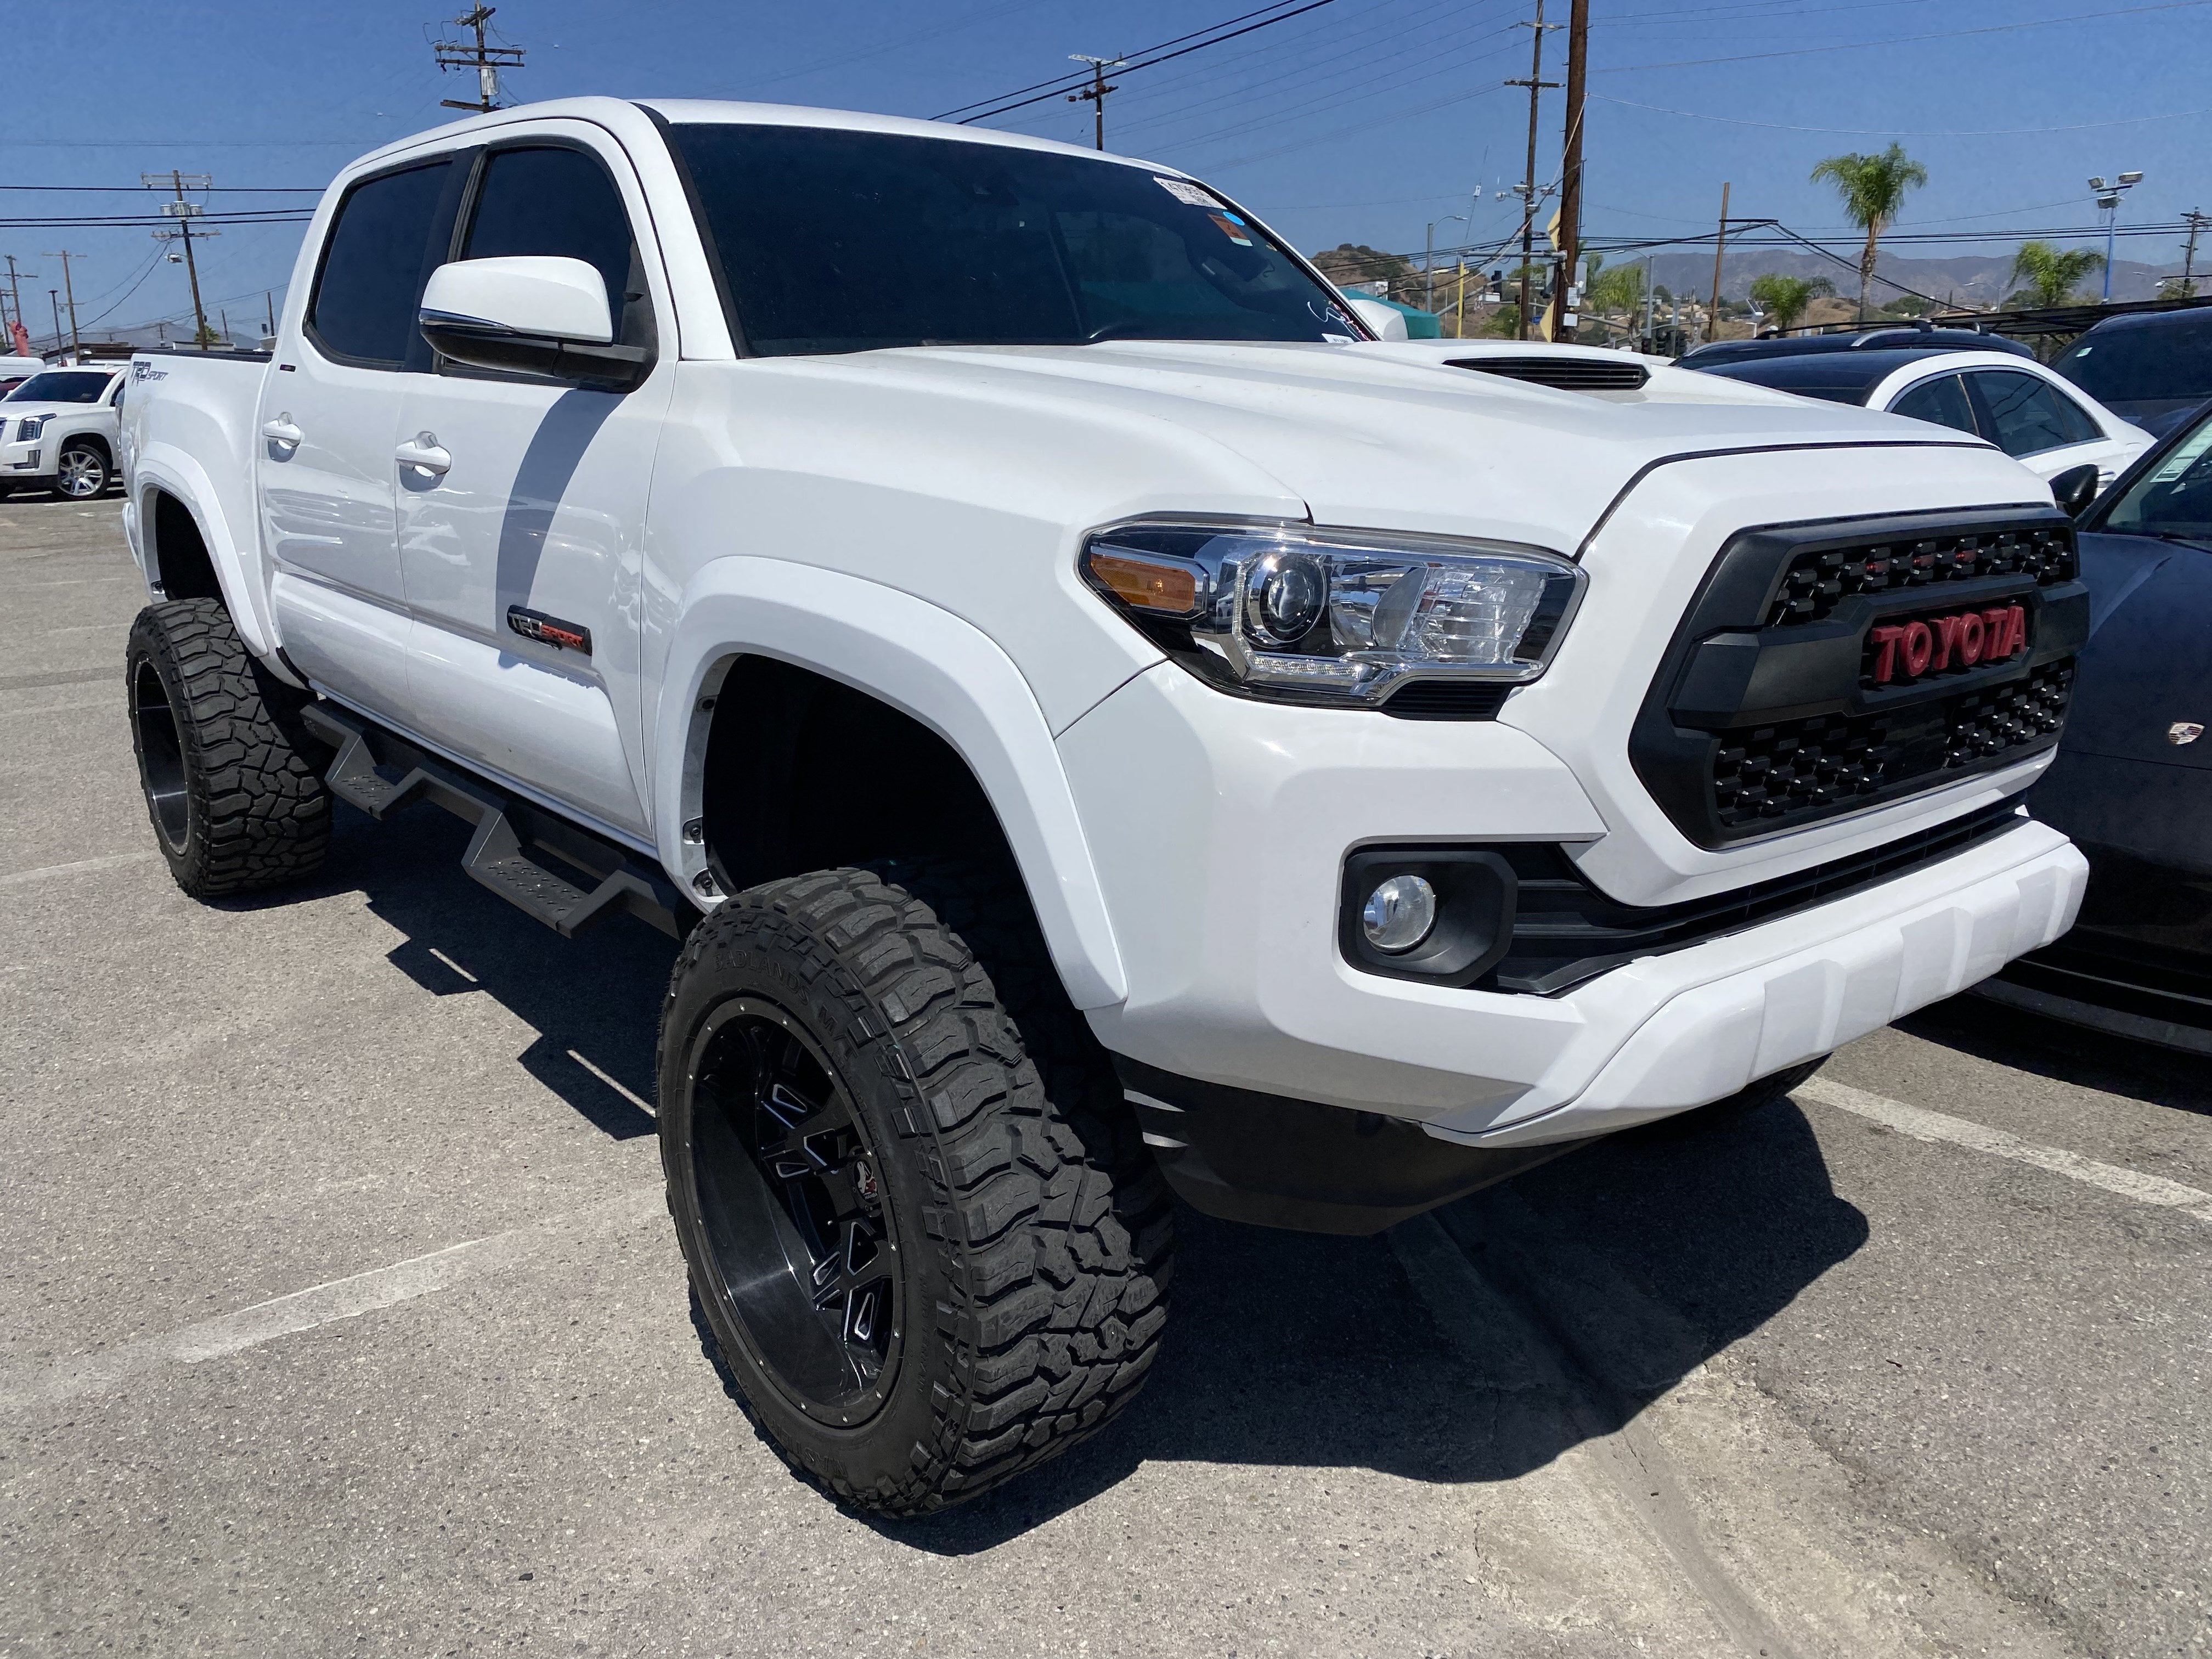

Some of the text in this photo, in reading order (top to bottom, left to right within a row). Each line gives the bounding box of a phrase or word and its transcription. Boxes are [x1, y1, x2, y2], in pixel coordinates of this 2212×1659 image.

[131, 361, 169, 386] TRD SPORT
[508, 612, 583, 647] TRD SPORT
[1871, 606, 2027, 683] TOYOTA
[714, 949, 811, 1006] BADLANDS
